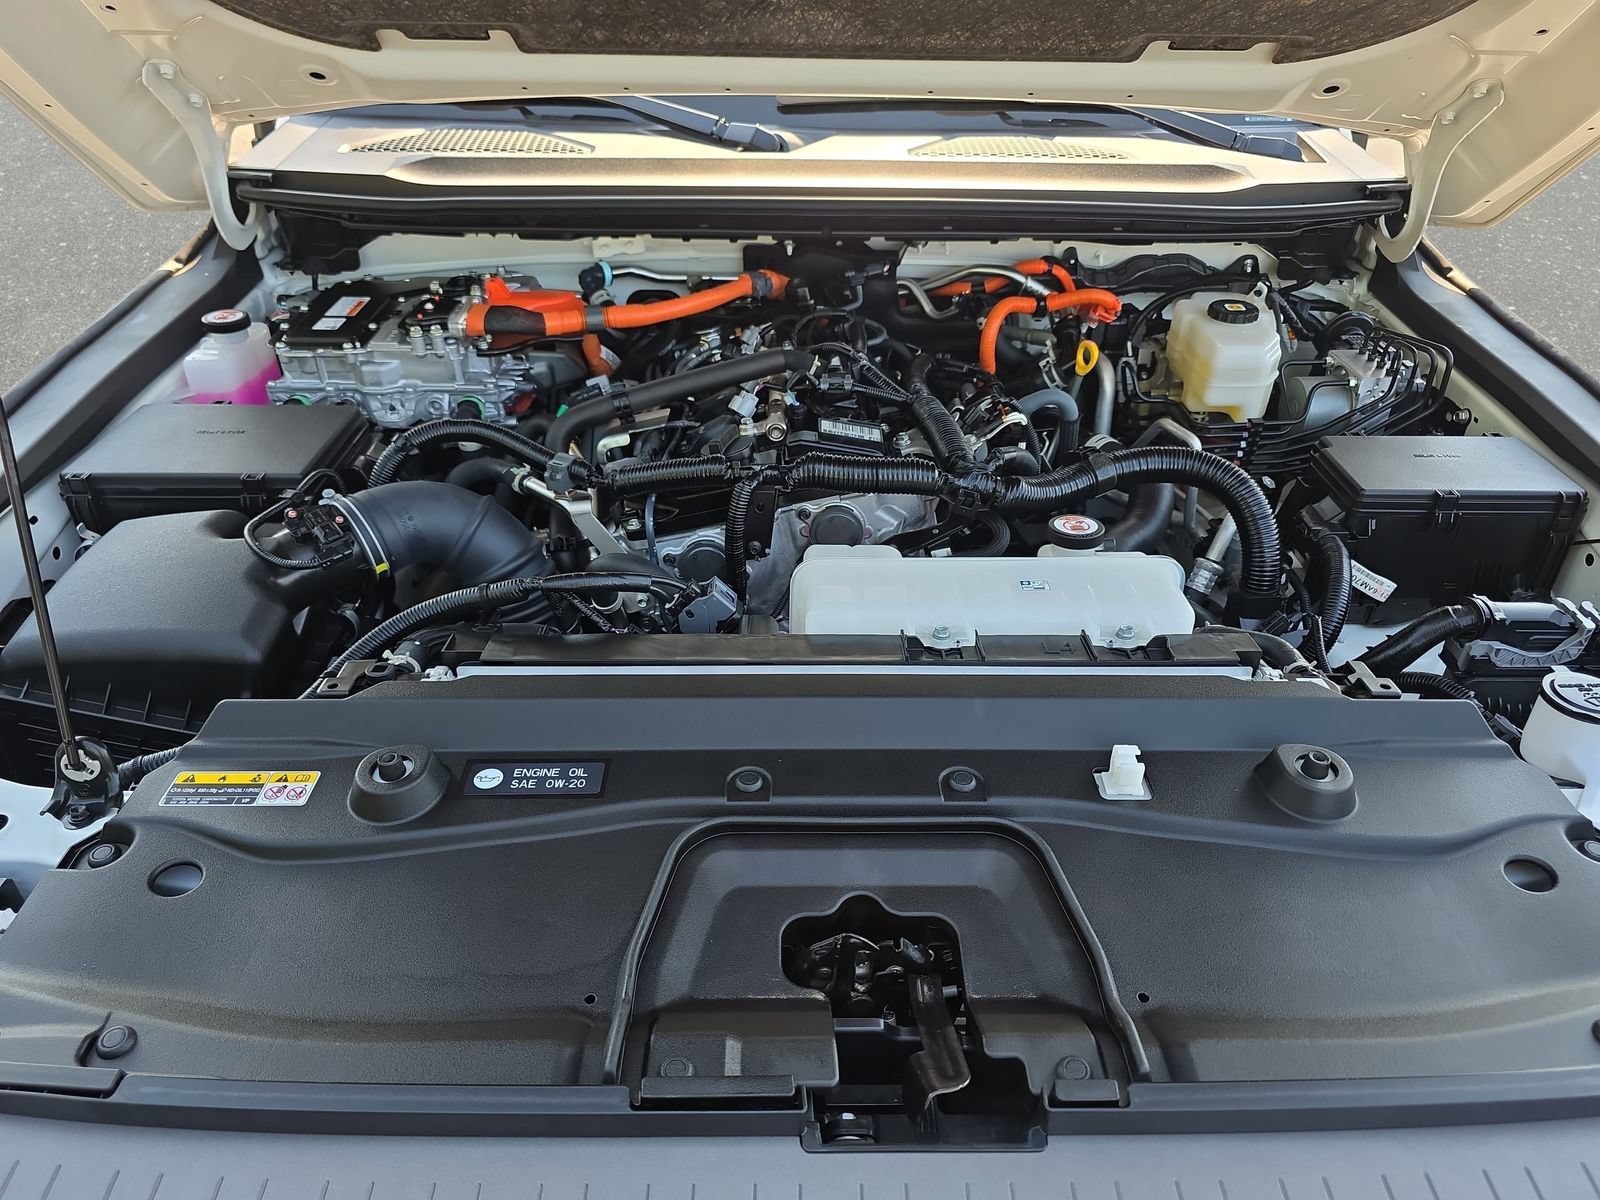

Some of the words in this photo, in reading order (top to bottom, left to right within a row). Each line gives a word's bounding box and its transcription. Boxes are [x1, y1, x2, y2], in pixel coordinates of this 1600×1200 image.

[513, 768, 560, 777] ENGINE
[568, 768, 588, 777] OIL
[510, 779, 537, 789] SAE
[545, 779, 586, 788] 0W-20
